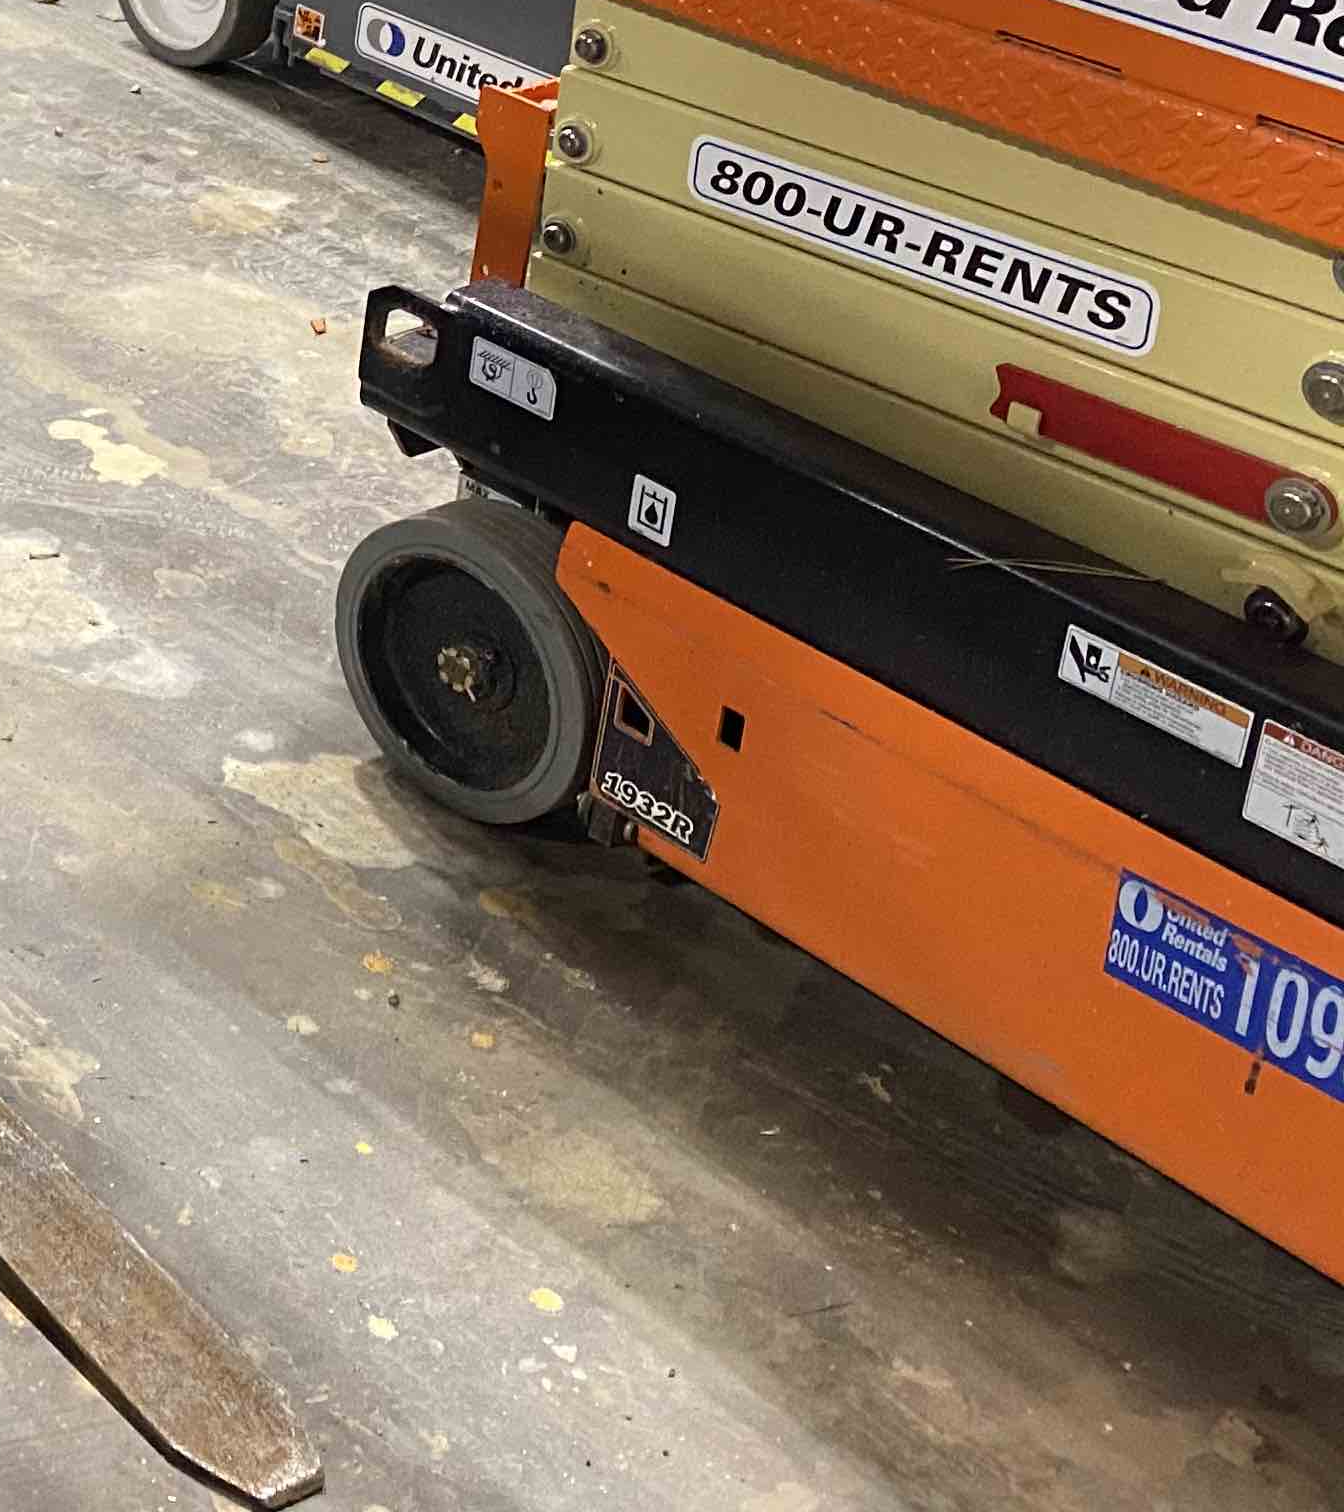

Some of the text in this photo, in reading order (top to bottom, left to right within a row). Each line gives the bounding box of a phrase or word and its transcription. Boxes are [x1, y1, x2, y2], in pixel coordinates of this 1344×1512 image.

[710, 159, 1132, 331] 800-UR-RENTS
[601, 771, 694, 845] 1932R
[1108, 928, 1225, 1020] 800.UR.RENTS
[1162, 921, 1229, 973] Rentals
